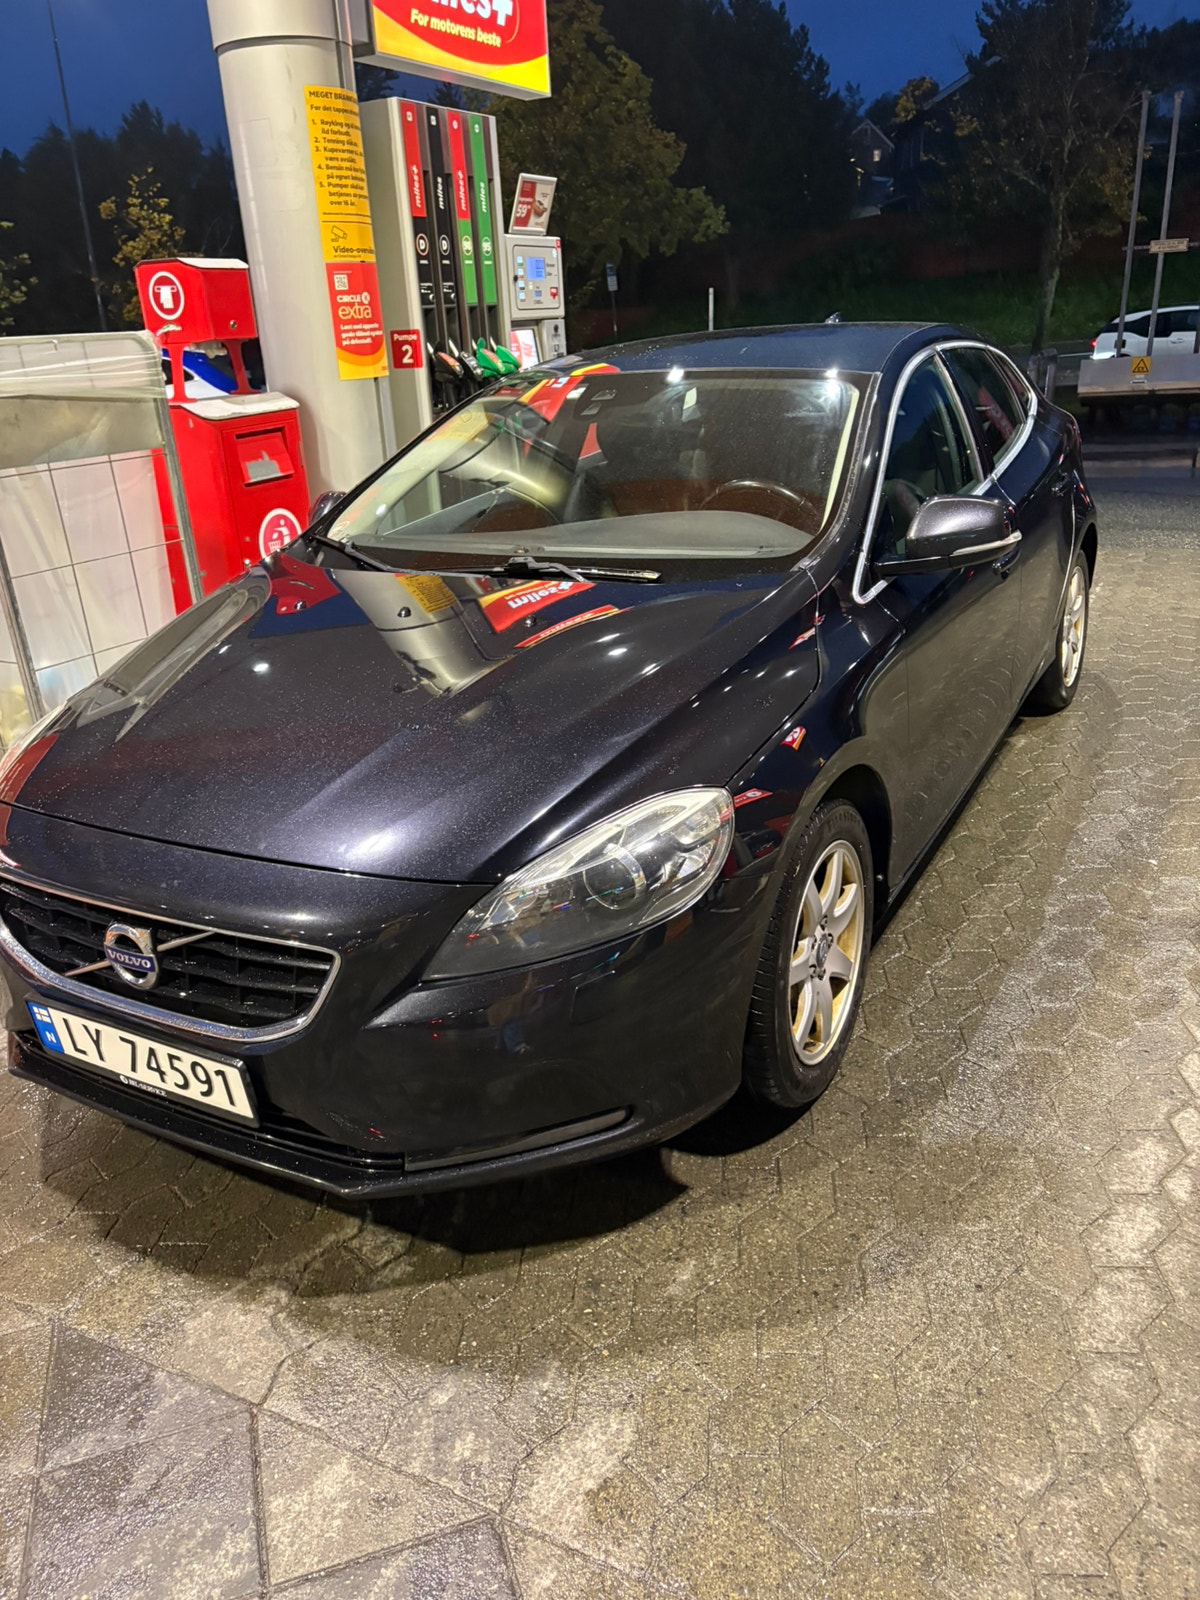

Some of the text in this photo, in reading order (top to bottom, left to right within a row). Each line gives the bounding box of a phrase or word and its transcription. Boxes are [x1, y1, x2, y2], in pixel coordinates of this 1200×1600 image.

[410, 8, 502, 47] For motorens beste
[308, 91, 333, 99] MEGET
[437, 176, 445, 210] miles
[480, 182, 488, 213] miles
[419, 239, 425, 250] D
[442, 240, 448, 250] D
[337, 294, 361, 303] CIRCLE
[338, 302, 372, 319] extra
[393, 332, 418, 341] Pumpe
[401, 345, 414, 364] 2
[107, 950, 151, 968] VOLVO
[46, 1031, 56, 1043] N
[63, 1017, 236, 1107] LY 74591
